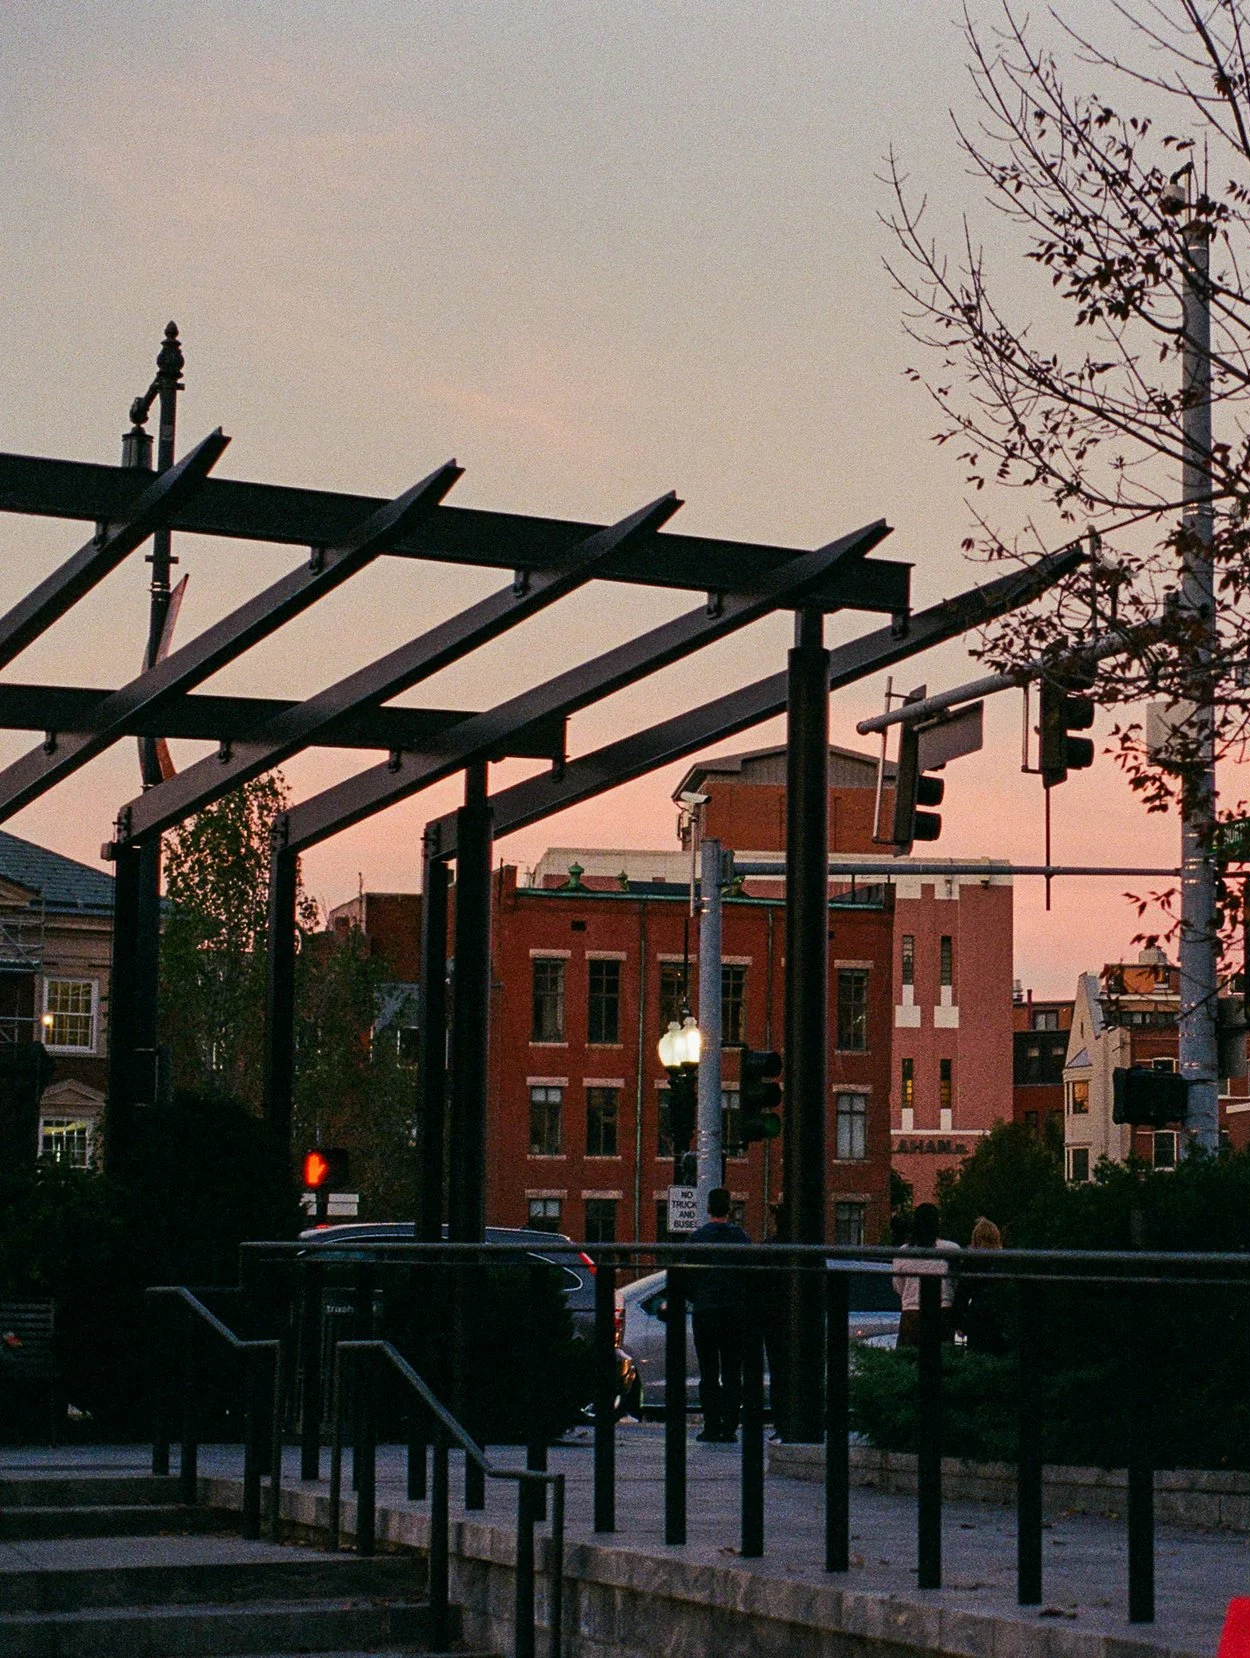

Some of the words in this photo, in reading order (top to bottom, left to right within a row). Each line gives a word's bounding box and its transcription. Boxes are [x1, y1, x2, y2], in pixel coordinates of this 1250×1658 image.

[890, 1138, 952, 1155] AHAN
[681, 1190, 693, 1199] NO
[671, 1200, 698, 1209] TRUCK
[679, 1210, 695, 1219] AND
[326, 1303, 354, 1314] trash
